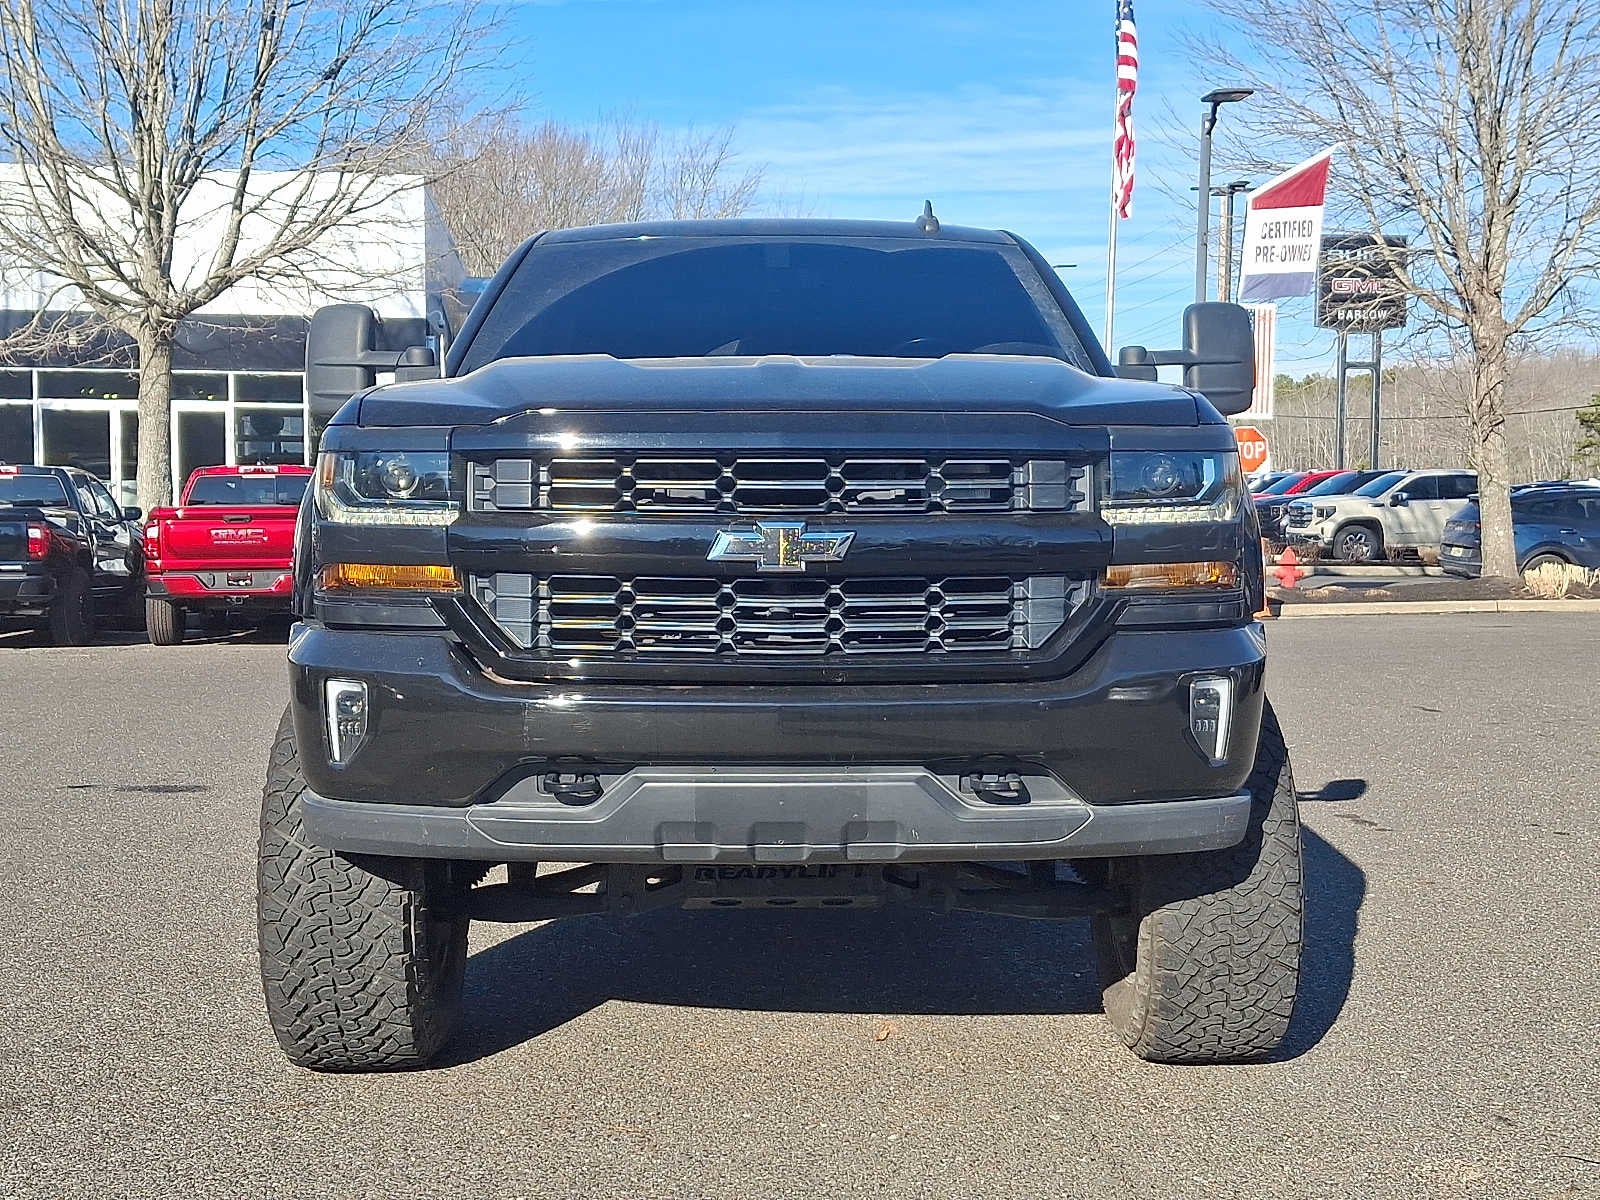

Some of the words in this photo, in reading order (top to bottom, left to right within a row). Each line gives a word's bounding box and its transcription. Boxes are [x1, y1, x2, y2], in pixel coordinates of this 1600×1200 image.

[1261, 219, 1313, 240] CERTIFIED
[1237, 441, 1265, 459] TOP
[210, 528, 265, 540] GMC
